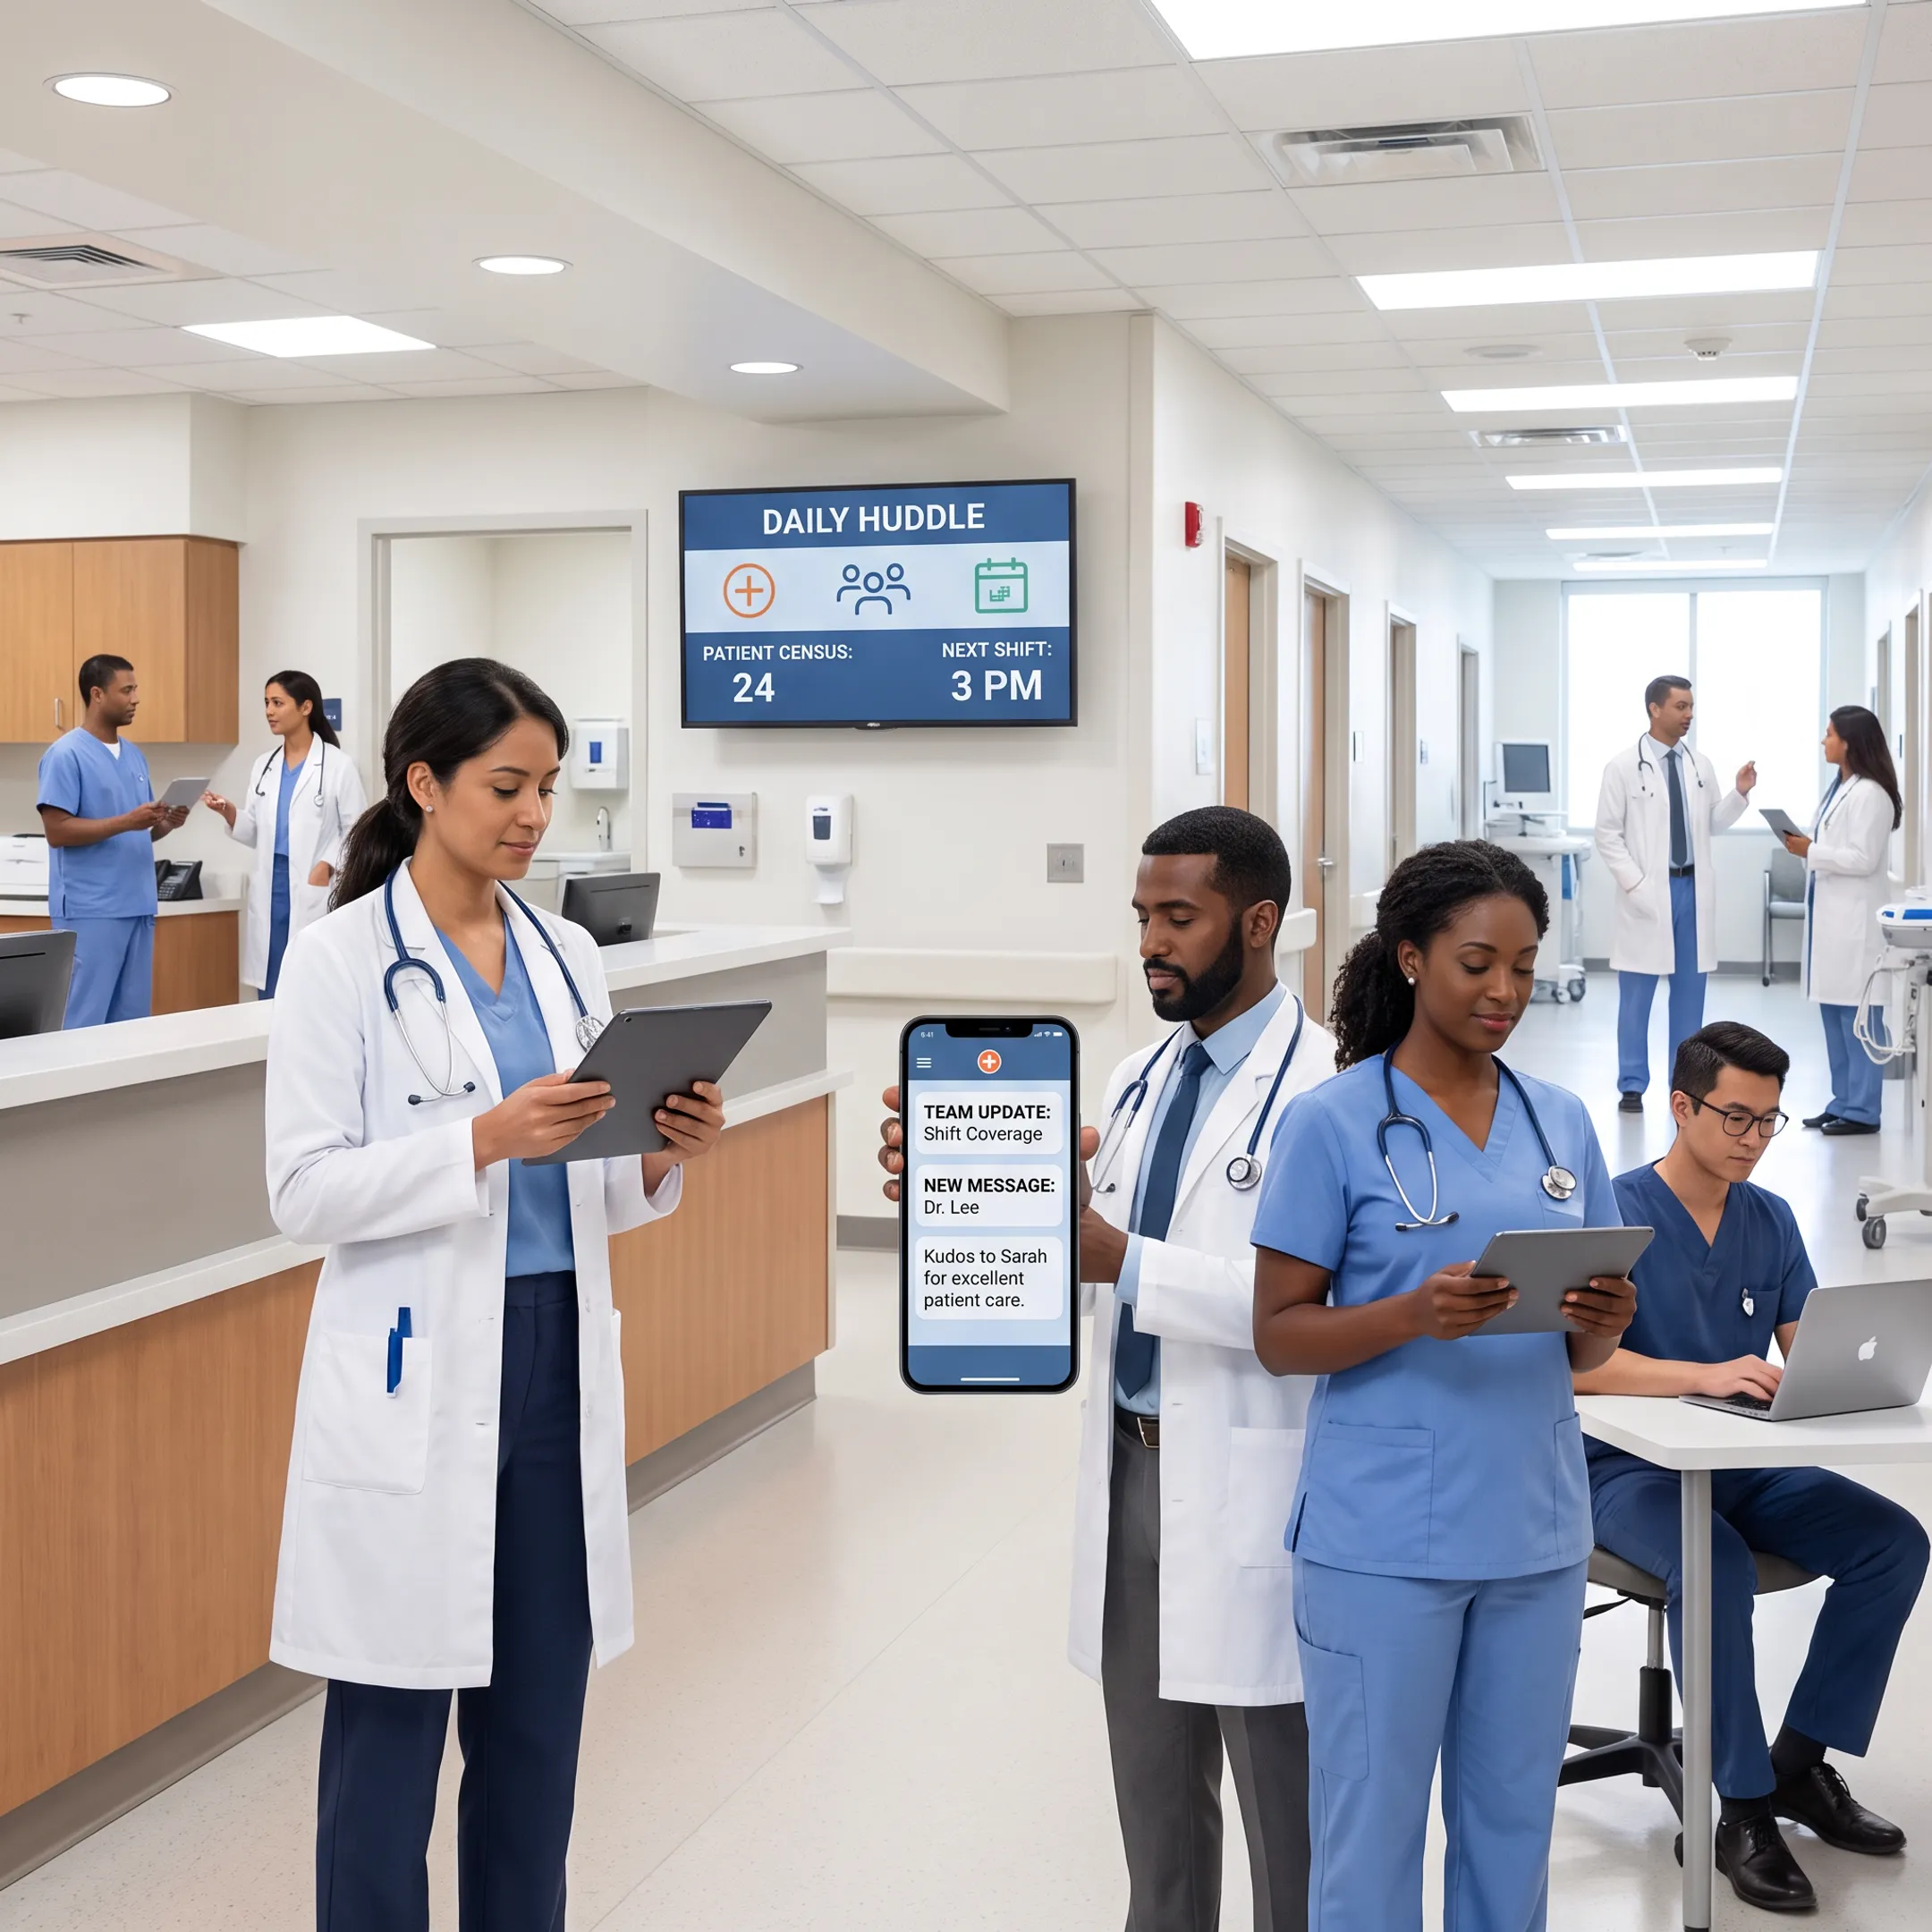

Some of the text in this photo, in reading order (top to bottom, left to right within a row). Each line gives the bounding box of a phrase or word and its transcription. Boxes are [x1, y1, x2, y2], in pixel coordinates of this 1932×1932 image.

[763, 503, 985, 535] DAILY HUDDLE
[703, 644, 853, 661] PATIENT CENSUS:
[942, 640, 1052, 658] NEXT SHIFT:
[733, 672, 775, 703] 24
[951, 669, 1042, 701] 3 PM
[923, 1105, 1051, 1120] TEAM UPDATE:
[924, 1125, 1043, 1145] Shift Coverage
[924, 1178, 1055, 1193] NEW MESSAGE:
[924, 1199, 979, 1215] Dr. Lee
[924, 1248, 1047, 1264] Kudos to Sarah
[923, 1269, 1025, 1285] for excellent
[924, 1292, 1024, 1311] patient care.
